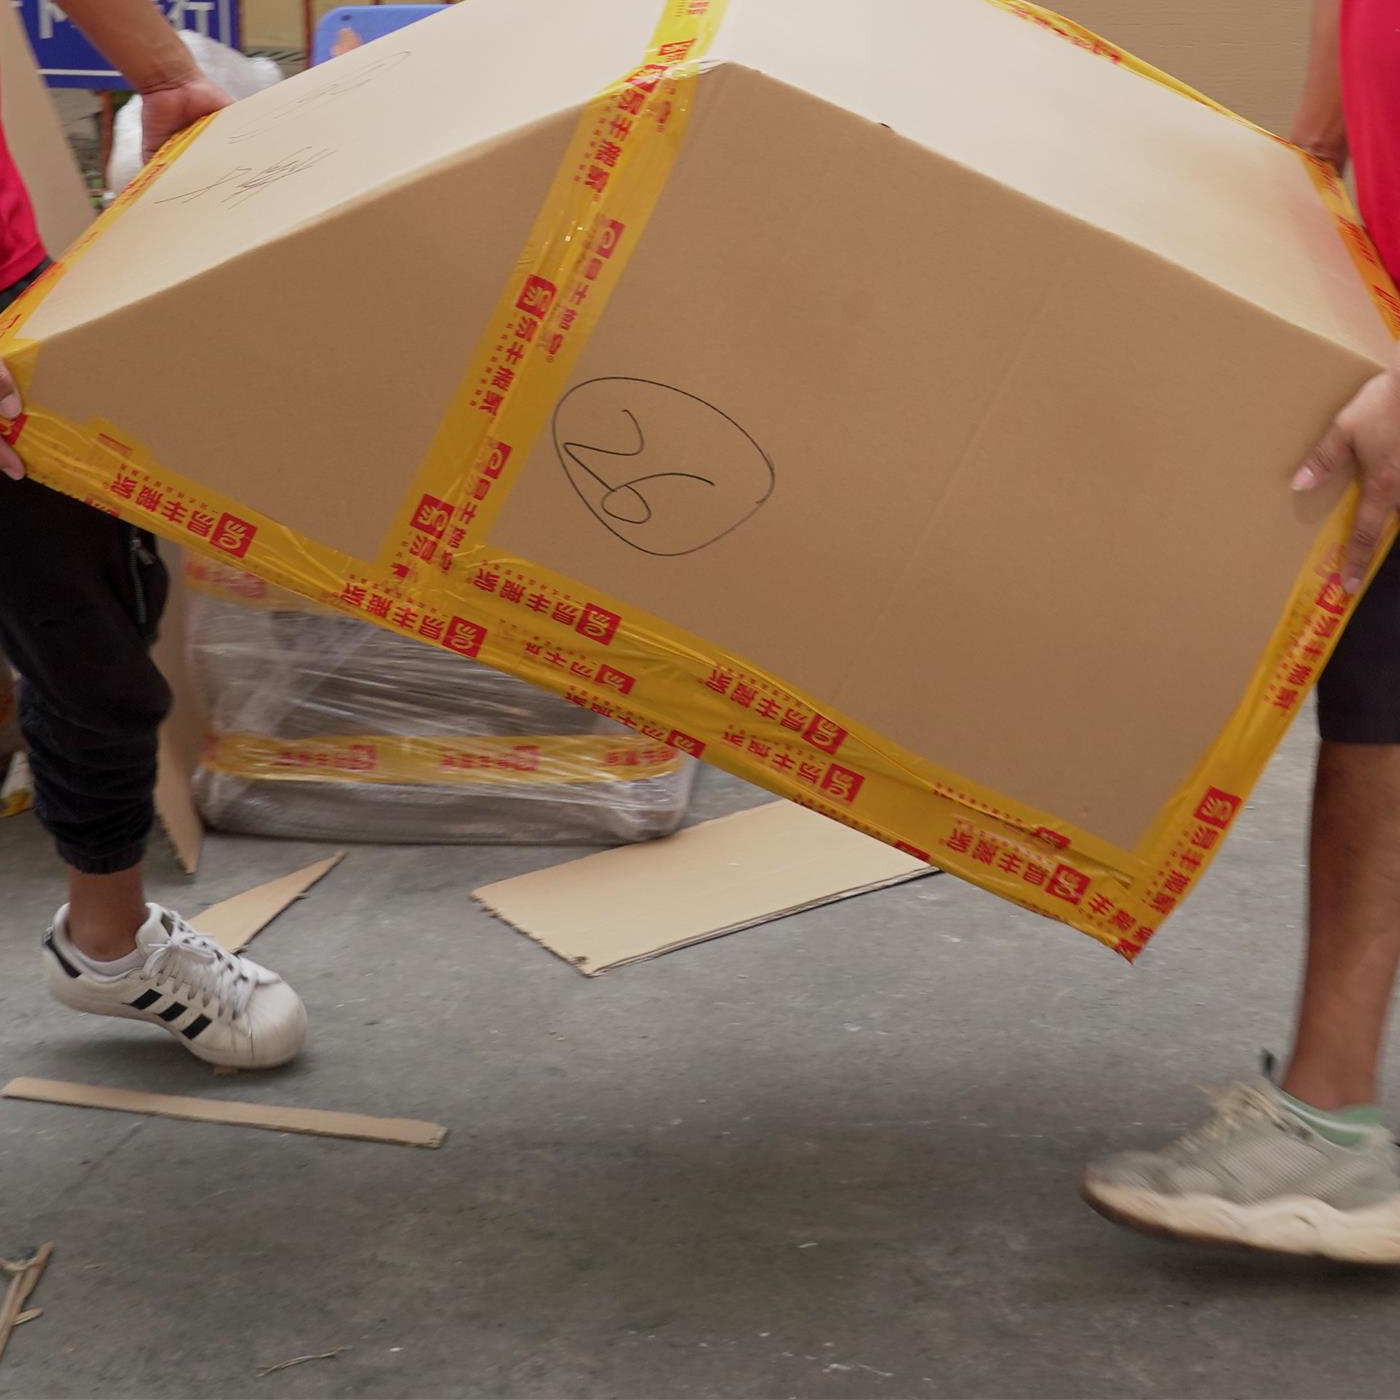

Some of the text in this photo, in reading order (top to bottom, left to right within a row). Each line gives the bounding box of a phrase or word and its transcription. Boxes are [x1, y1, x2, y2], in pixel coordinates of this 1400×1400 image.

[585, 88, 646, 194] 易丰搬家
[480, 315, 538, 416] 易丰搬家
[111, 471, 219, 539] 易丰搬家
[341, 582, 446, 641] 易丰搬家
[474, 567, 581, 627] 易丰搬家
[705, 668, 809, 733] 易丰搬家
[946, 827, 1050, 888] 易丰搬家
